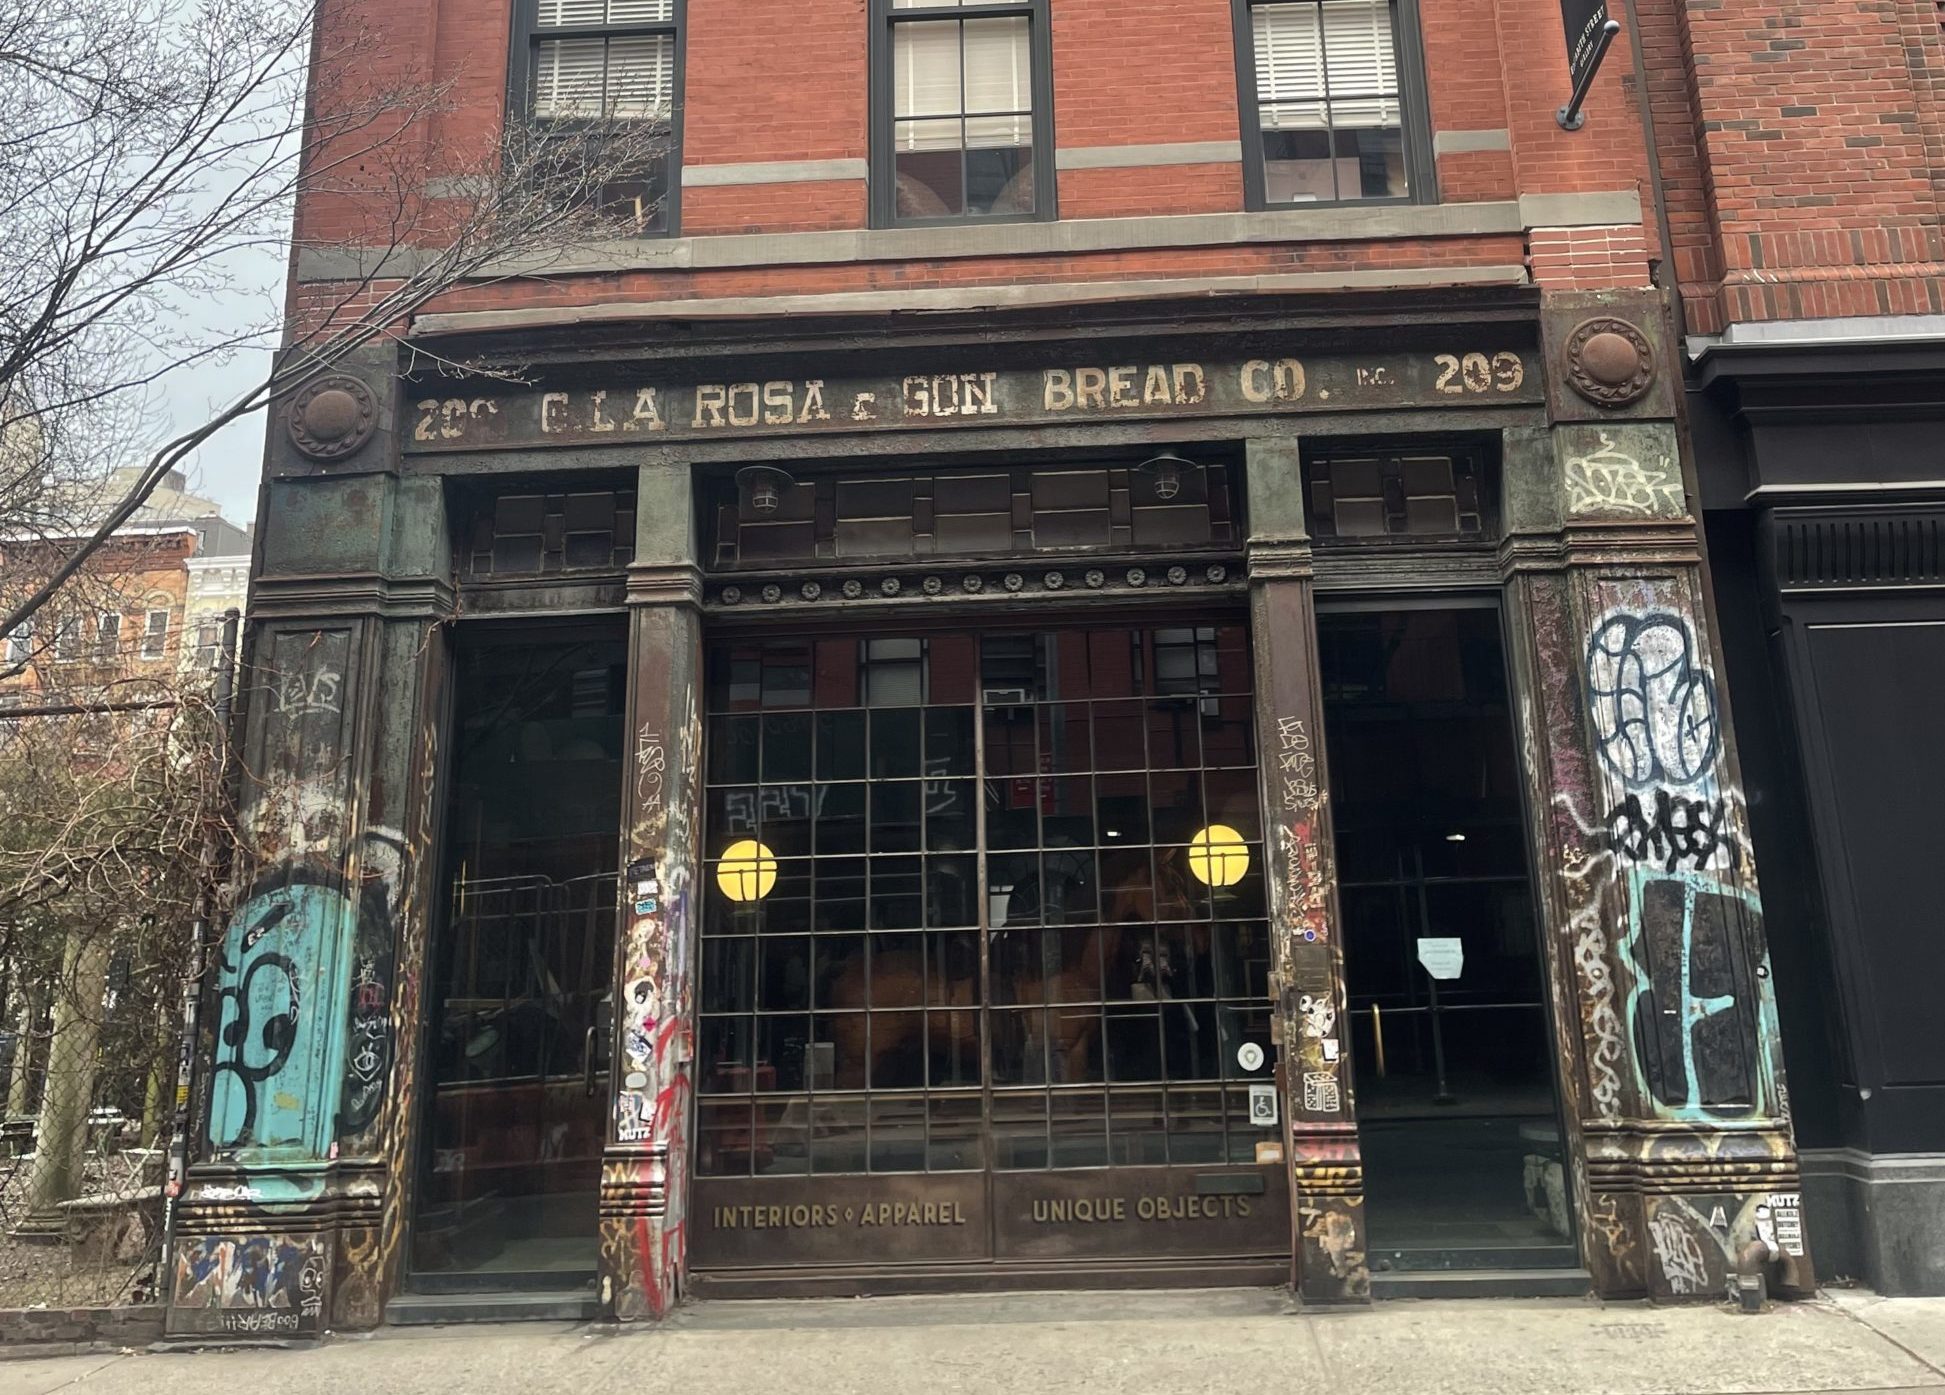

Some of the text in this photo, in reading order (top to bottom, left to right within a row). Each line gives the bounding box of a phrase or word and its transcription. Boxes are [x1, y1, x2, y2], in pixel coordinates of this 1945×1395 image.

[1584, 4, 1605, 37] STREET
[691, 379, 831, 429] ROSA
[902, 371, 998, 417] SON
[1042, 362, 1206, 411] BREAD
[1433, 351, 1524, 394] 209
[713, 1201, 967, 1229] INTERIORS APPAREL
[1032, 1194, 1251, 1222] UNIQUE OBJECTS
